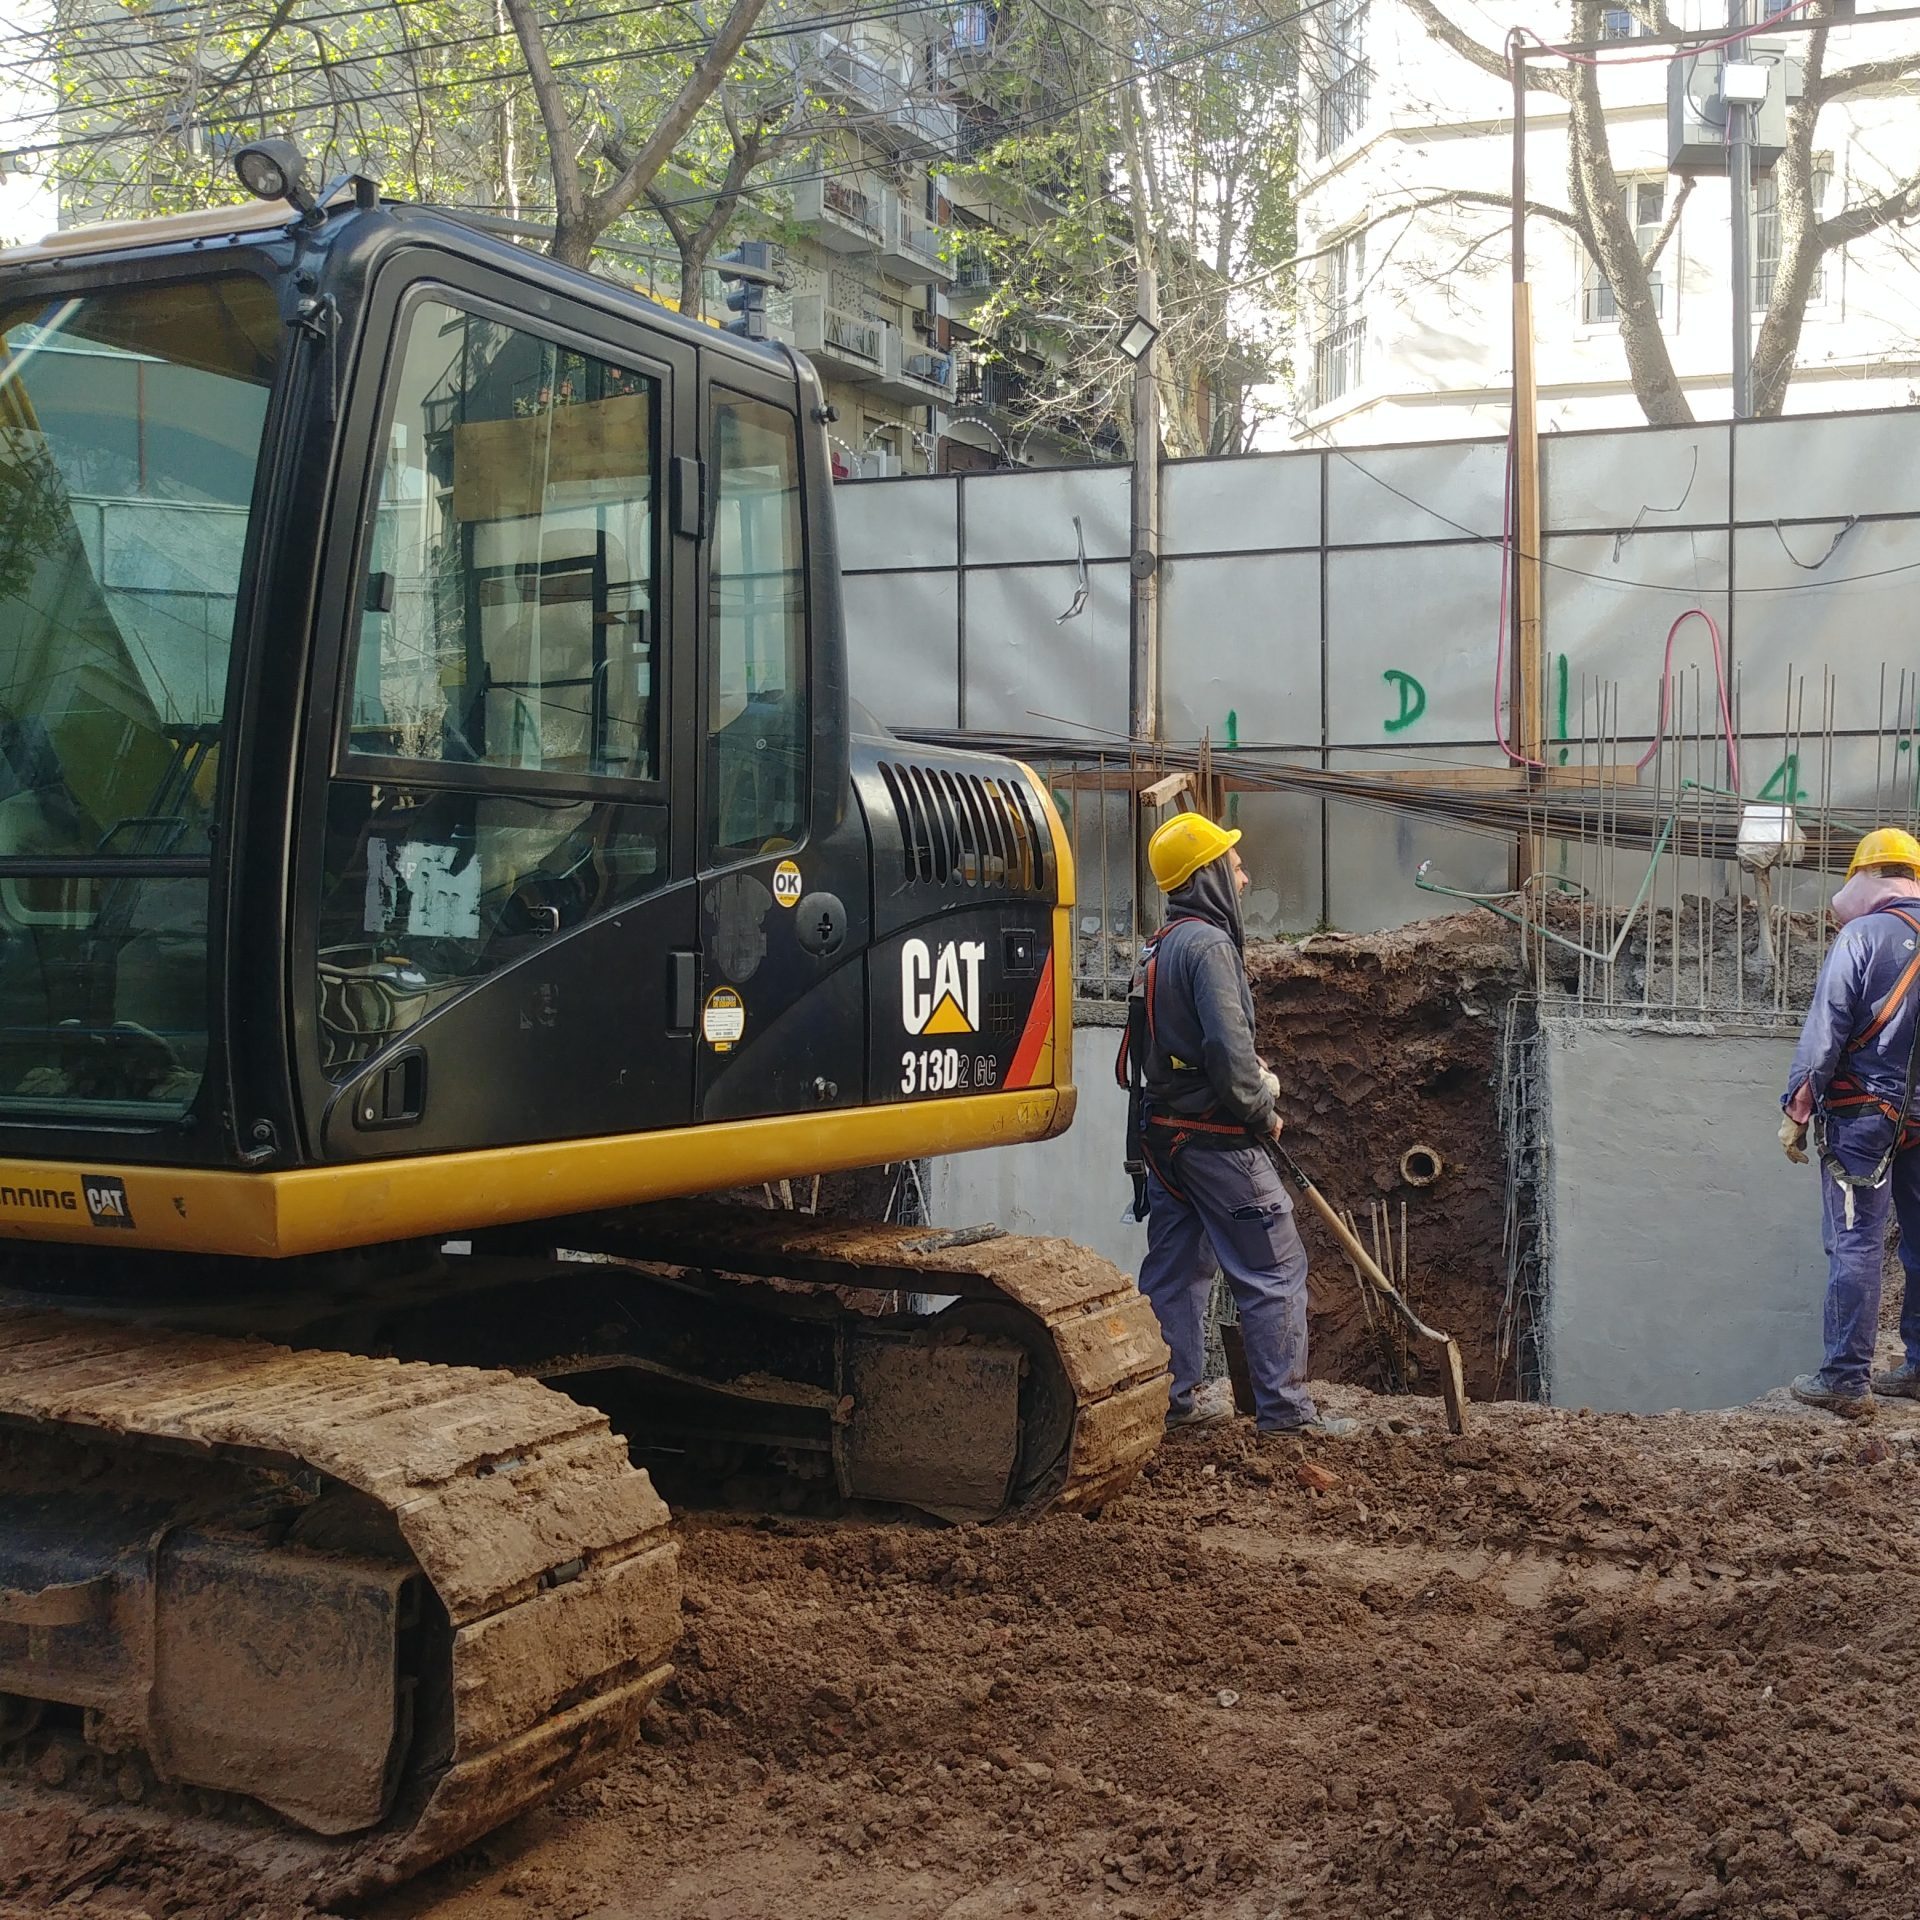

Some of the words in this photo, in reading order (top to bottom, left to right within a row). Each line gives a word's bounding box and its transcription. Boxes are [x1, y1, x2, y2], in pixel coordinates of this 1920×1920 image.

[1383, 669, 1426, 732] D
[775, 873, 800, 894] OK
[902, 938, 985, 1035] CAT
[0, 1186, 78, 1210] NNING
[87, 1188, 125, 1217] CAT
